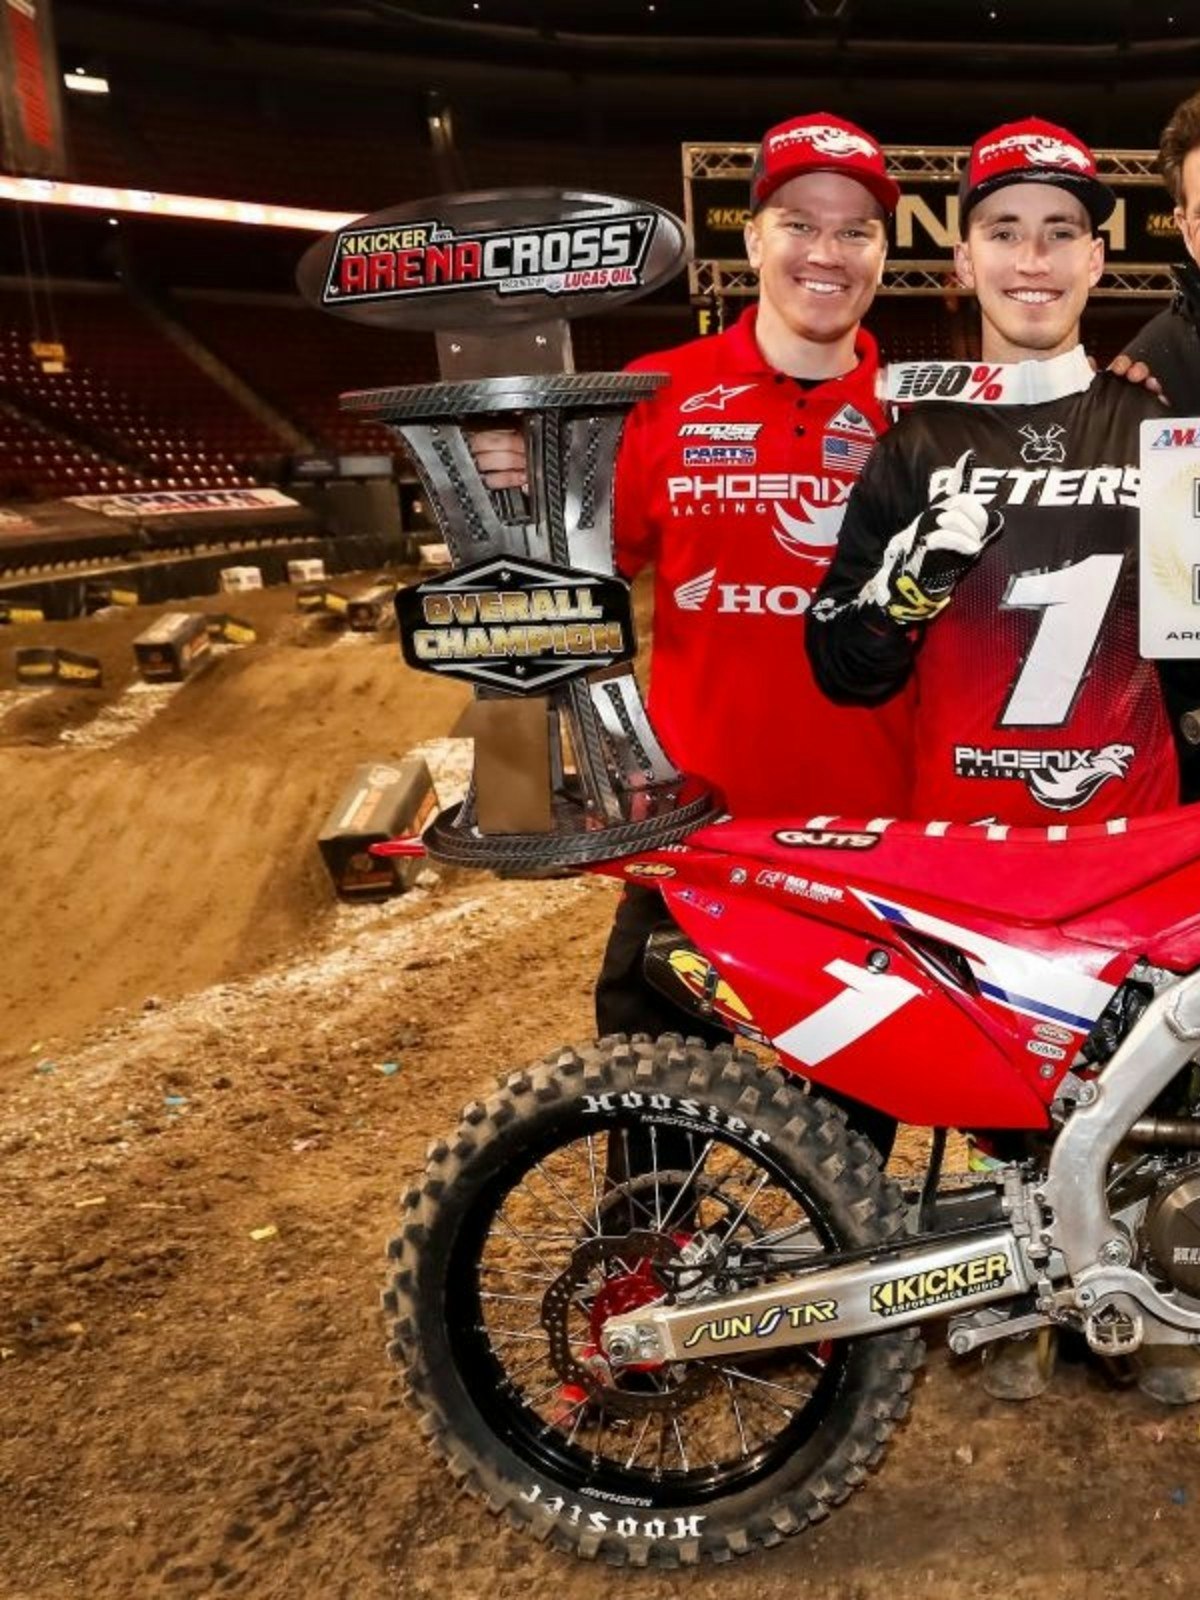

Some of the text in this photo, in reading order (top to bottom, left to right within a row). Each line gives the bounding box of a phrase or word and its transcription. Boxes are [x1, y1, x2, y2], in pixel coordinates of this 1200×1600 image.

[354, 230, 427, 253] KICKER
[339, 224, 631, 293] ARENACROSS
[563, 267, 634, 288] LUCAS OIL
[896, 365, 1003, 401] 100%
[678, 423, 763, 437] MOOSE
[685, 448, 754, 459] PARTS
[667, 475, 854, 503] PHOENIX
[671, 503, 767, 517] RACING
[424, 588, 603, 624] OVERALL
[717, 584, 817, 615] HO
[413, 623, 624, 659] CHAMPION
[998, 553, 1125, 728] 1
[955, 746, 1093, 769] PHOENIX
[956, 767, 1026, 780] RACING
[776, 831, 877, 847] GUTS
[771, 957, 924, 1067] 1
[896, 1253, 1007, 1305] KICKER
[883, 1279, 1001, 1317] PERFORMANCE AUDIO
